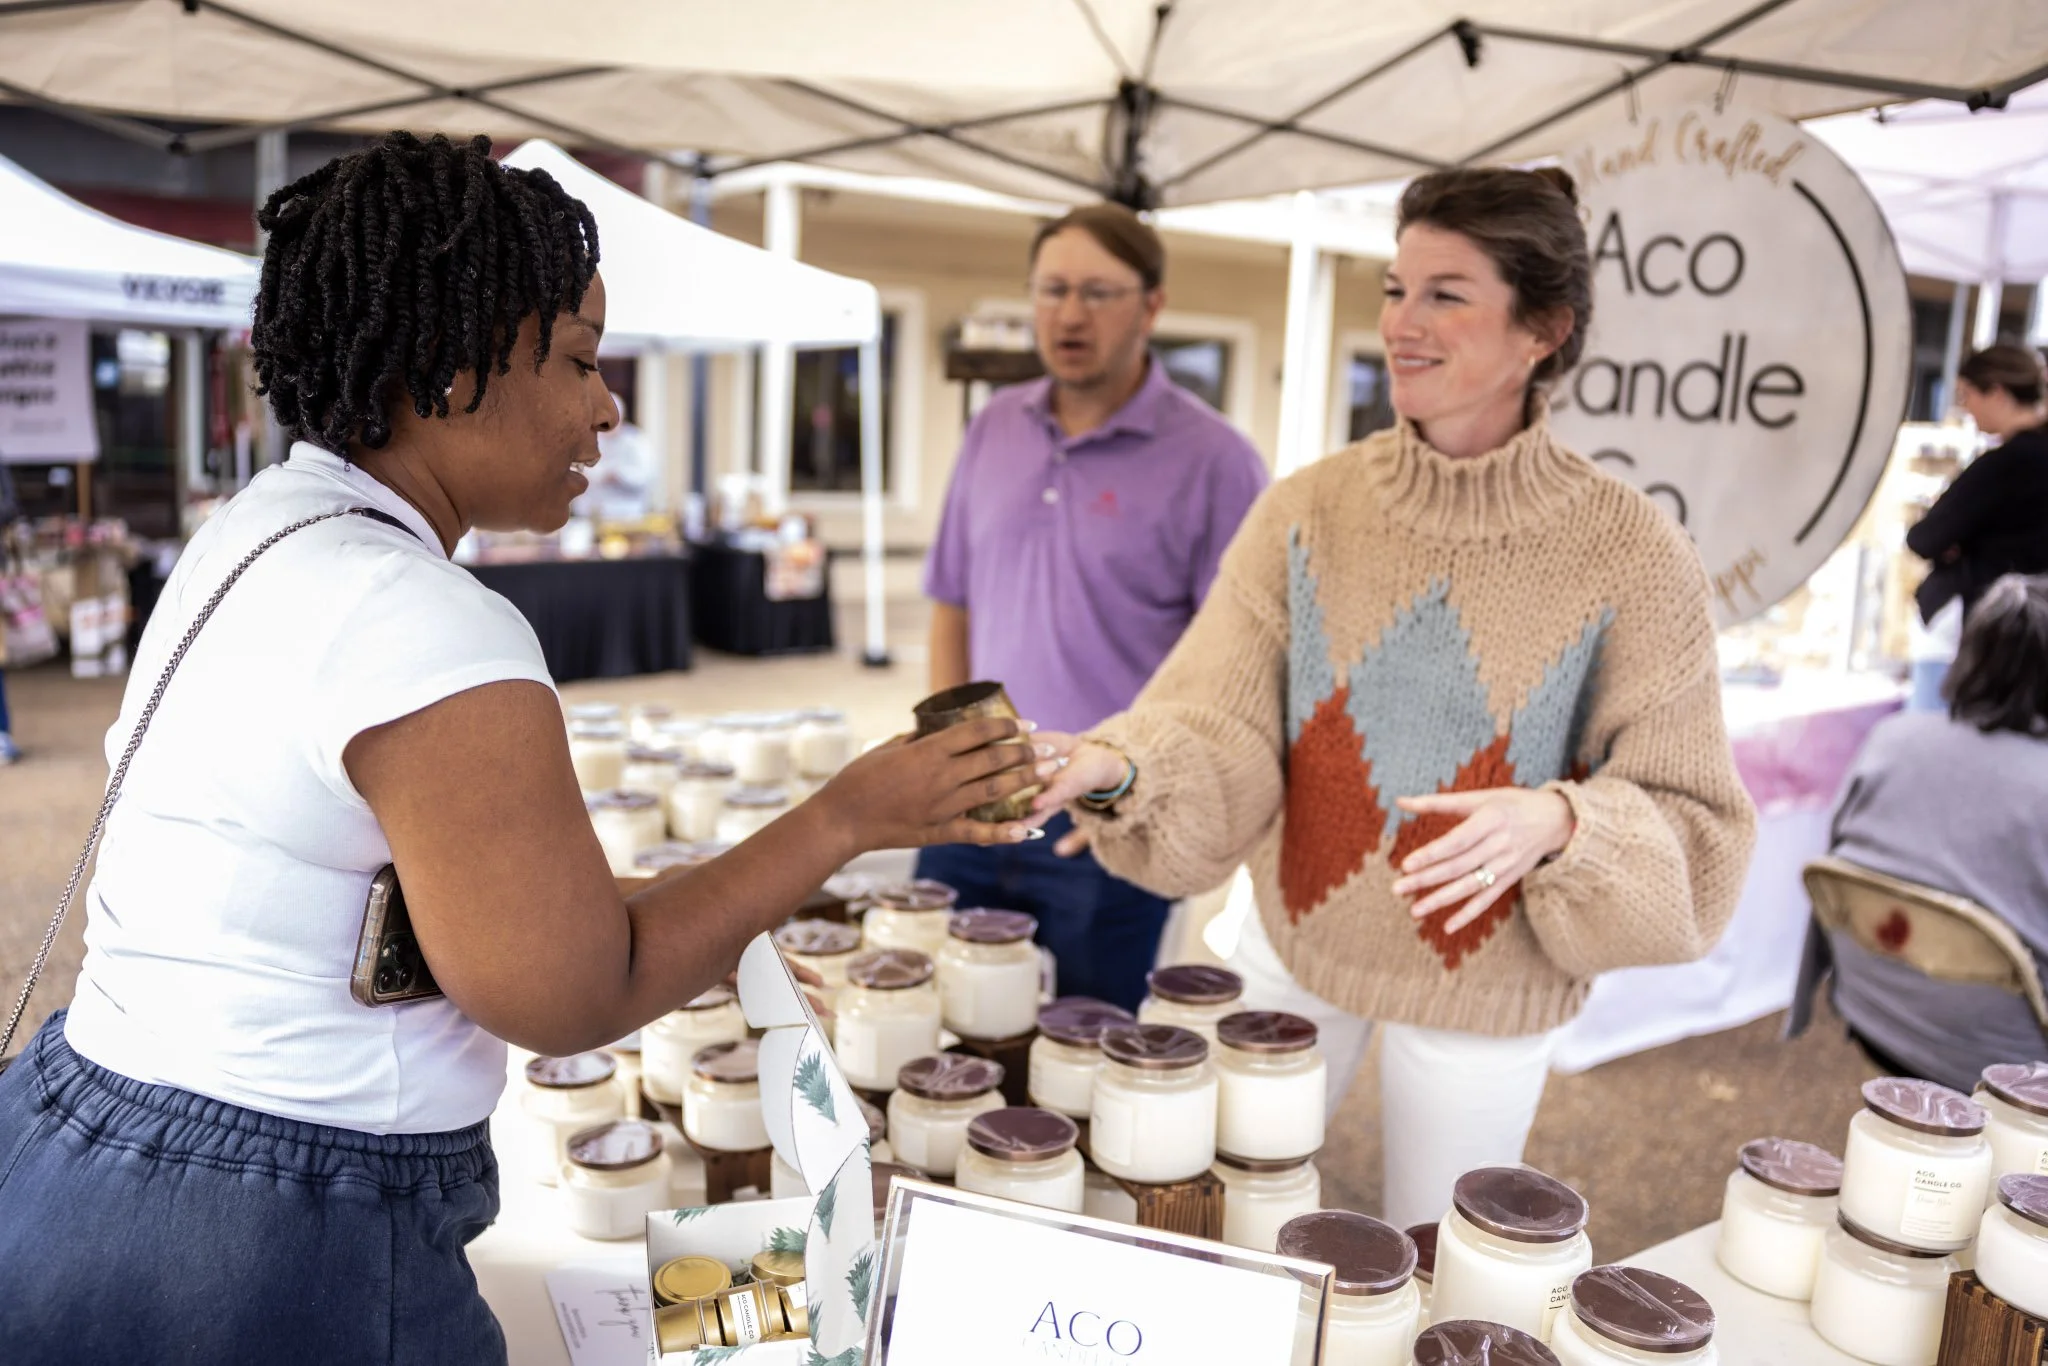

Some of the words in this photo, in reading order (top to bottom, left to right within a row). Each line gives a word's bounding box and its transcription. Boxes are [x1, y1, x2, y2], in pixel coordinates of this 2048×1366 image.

[1674, 110, 1806, 187] Crafted
[1591, 209, 1745, 297] Aco
[1551, 332, 1805, 430] andle
[743, 1304, 753, 1330] CANDLE
[1552, 1285, 1568, 1293] ACO
[1029, 1300, 1143, 1356] ACO
